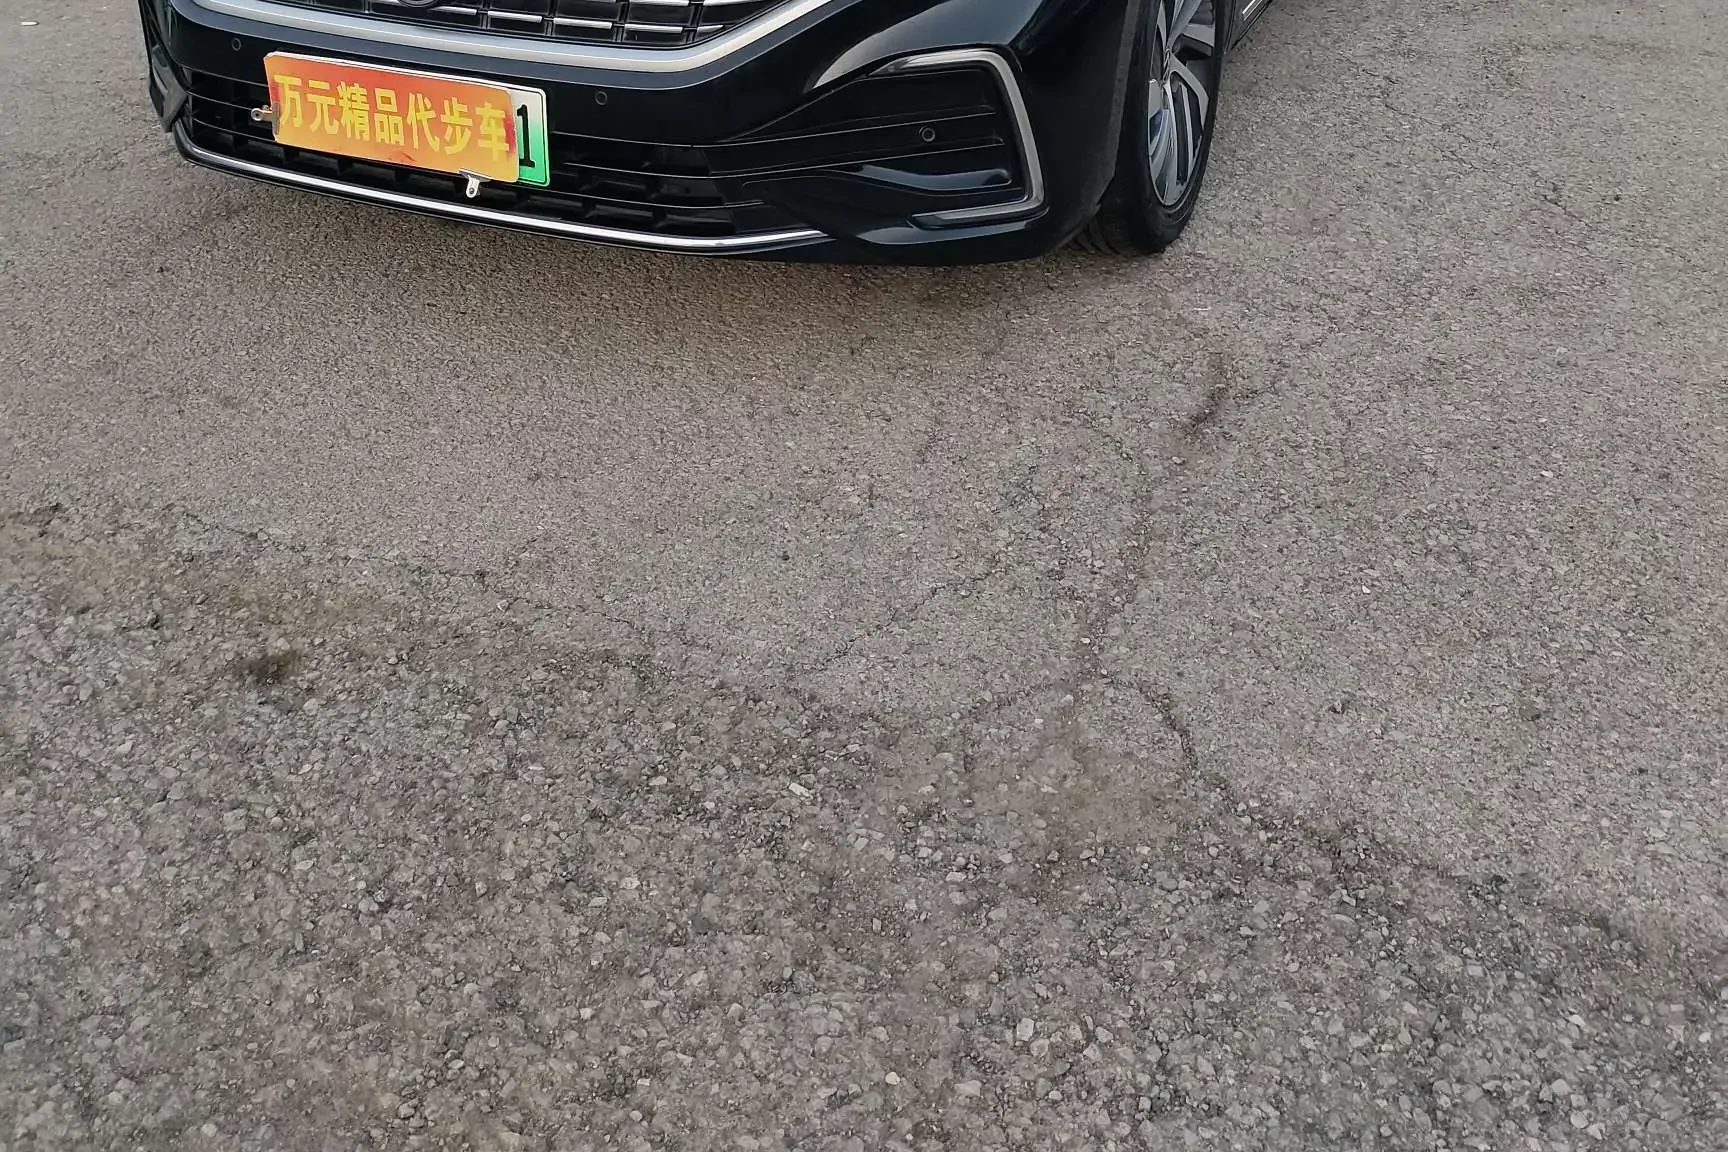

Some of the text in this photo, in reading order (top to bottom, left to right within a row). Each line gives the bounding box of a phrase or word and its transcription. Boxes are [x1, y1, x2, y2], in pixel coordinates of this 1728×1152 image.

[273, 74, 510, 162] 万元精品代步车
[516, 104, 536, 168] 1
